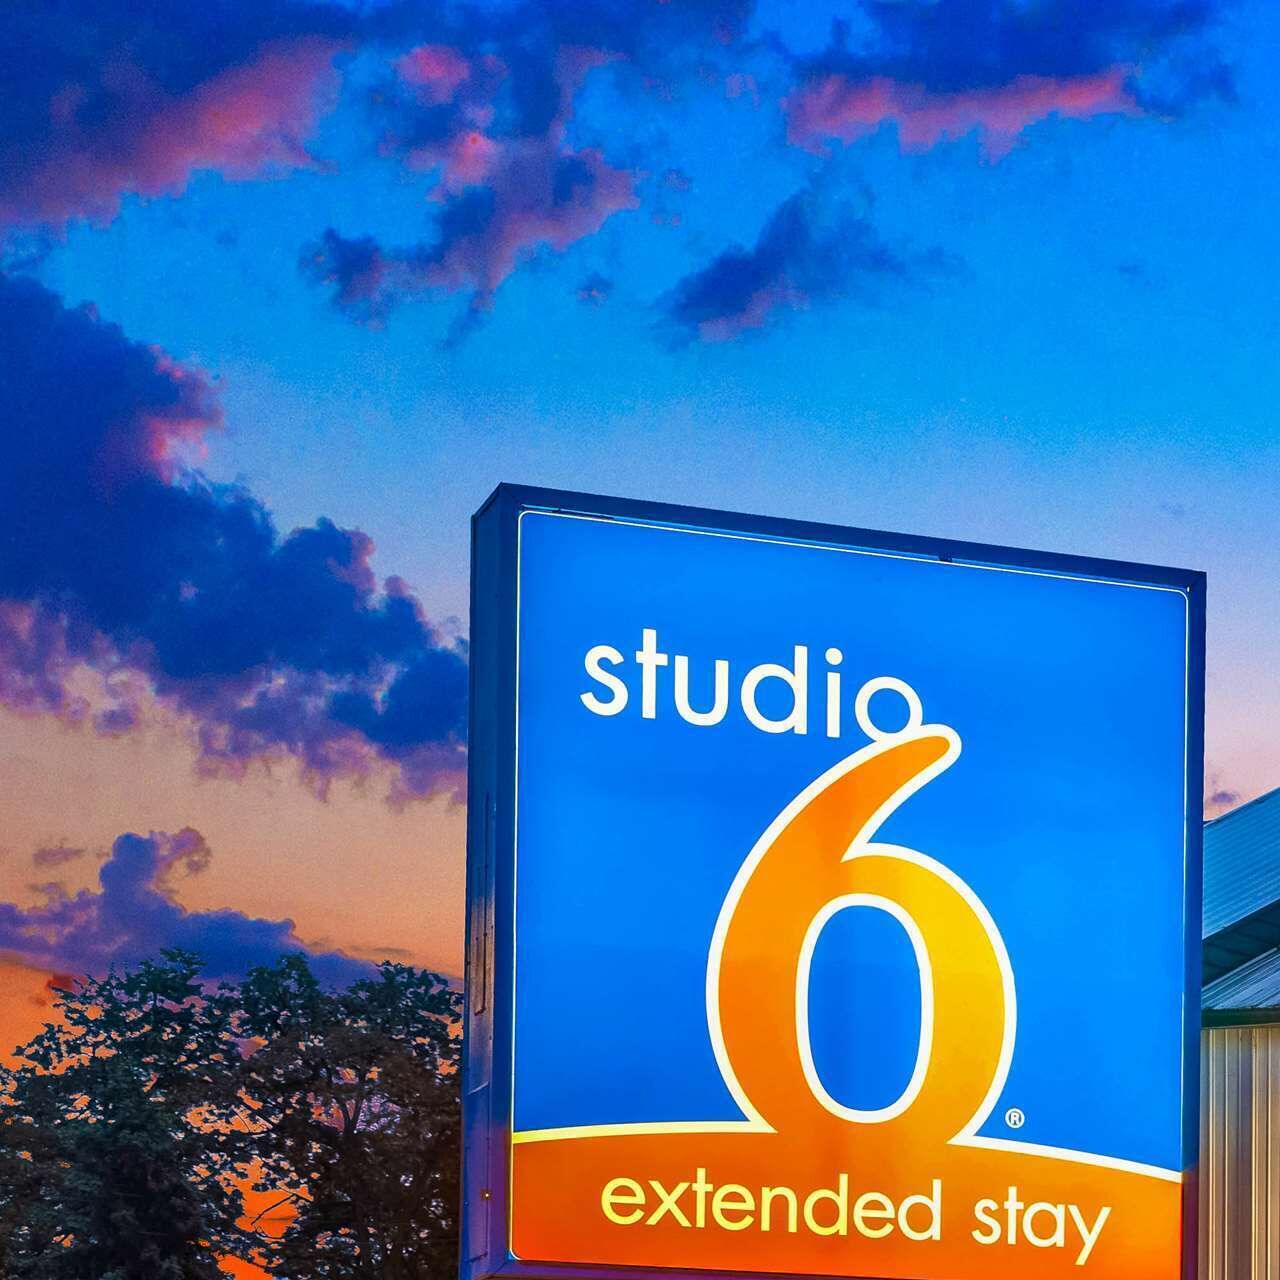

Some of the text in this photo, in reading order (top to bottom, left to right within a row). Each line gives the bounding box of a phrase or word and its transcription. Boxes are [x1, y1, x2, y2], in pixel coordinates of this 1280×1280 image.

[579, 628, 924, 743] studio
[705, 723, 1017, 1135] 6
[600, 1166, 1111, 1265] extended stay
